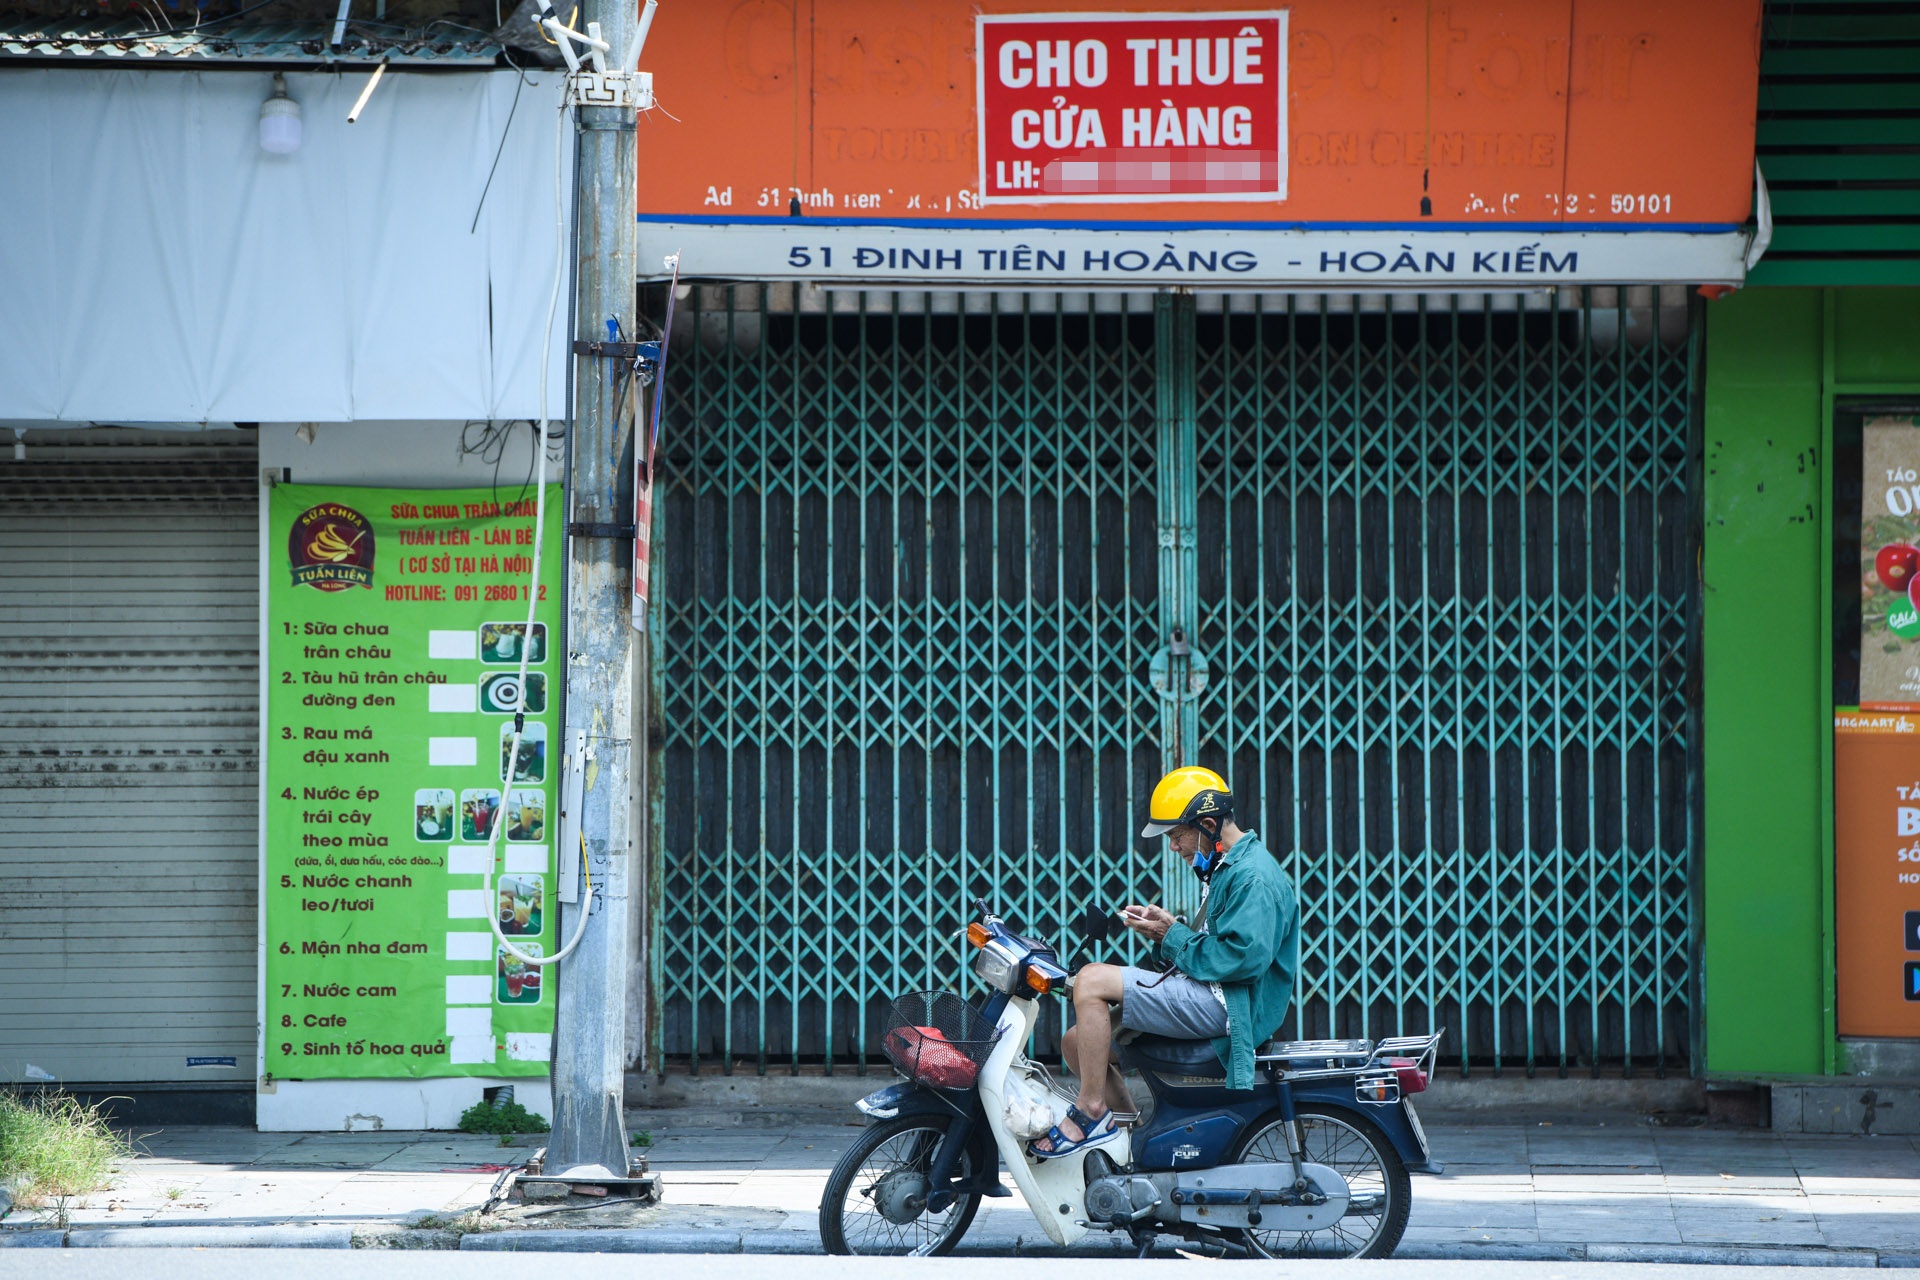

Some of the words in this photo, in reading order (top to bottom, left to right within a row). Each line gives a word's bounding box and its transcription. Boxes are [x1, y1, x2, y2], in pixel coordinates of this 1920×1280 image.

[999, 39, 1108, 89] CHO
[1126, 27, 1263, 86] THUÊ
[1011, 95, 1107, 149] CỬA
[1122, 99, 1252, 147] HÀNG
[996, 161, 1040, 189] LH:
[1611, 194, 1671, 214] 50101
[788, 246, 832, 268] 51
[852, 248, 962, 270] ĐINH
[978, 244, 1066, 271] TIÊN
[1084, 243, 1258, 272] HOÀNG
[1320, 244, 1455, 273] HOÀN
[1473, 243, 1578, 273] KIẾM
[1886, 466, 1917, 482] TÁO
[329, 507, 363, 527] CHUA
[391, 502, 419, 519] SỮA
[423, 504, 460, 519] CHUA
[464, 500, 500, 518] TRÂN
[399, 524, 435, 545] TUẤN
[439, 526, 470, 545] LIÊN
[409, 556, 428, 573] CƠ
[432, 552, 451, 573] SỞ
[455, 557, 476, 576] TẠI
[480, 554, 499, 573] HÀ
[503, 554, 533, 576] NỘI)
[298, 564, 335, 582] TUẤN
[338, 569, 367, 582] LIÊN
[385, 585, 446, 601] HOTLINE:
[455, 585, 478, 601] 091
[484, 585, 517, 601] 2680
[522, 585, 547, 601] 12
[304, 622, 337, 636] Sữa
[343, 622, 389, 636] chua
[304, 645, 340, 659] trân
[346, 645, 391, 659] châu
[282, 672, 297, 684] 2.
[302, 670, 333, 684] Tàu
[364, 671, 398, 684] trân
[404, 671, 447, 684] châu
[302, 693, 357, 710] đường
[363, 694, 395, 707] đen
[281, 727, 297, 740] 3.
[303, 727, 338, 740] Rau
[344, 725, 373, 740] má
[303, 749, 338, 767] đậu
[344, 750, 390, 763] xanh
[281, 787, 297, 800] 4.
[303, 786, 350, 800] Nước
[356, 786, 380, 803] ép
[303, 810, 333, 824] trái
[338, 810, 372, 826] cây
[302, 834, 343, 847] theo
[348, 833, 389, 847] mùa
[294, 856, 322, 868] (dứa,
[340, 857, 360, 866] dưa
[388, 857, 407, 866] cóc
[280, 875, 296, 888] 5.
[302, 874, 350, 888] Nước
[355, 875, 412, 888] chanh
[1899, 873, 1920, 883] HO
[302, 899, 374, 913] leo/tươi
[279, 942, 296, 955] 6.
[302, 940, 341, 958] Mận
[347, 942, 381, 954] nha
[387, 941, 428, 954] đam
[281, 985, 297, 997] 7.
[303, 983, 351, 997] Nước
[356, 986, 397, 997] cam
[281, 1014, 297, 1028] 8.
[303, 1014, 347, 1028] Cafe
[281, 1043, 297, 1056] 9.
[303, 1042, 340, 1056] Sinh
[346, 1039, 366, 1055] tố
[370, 1042, 405, 1055] hoa
[410, 1039, 446, 1057] quả
